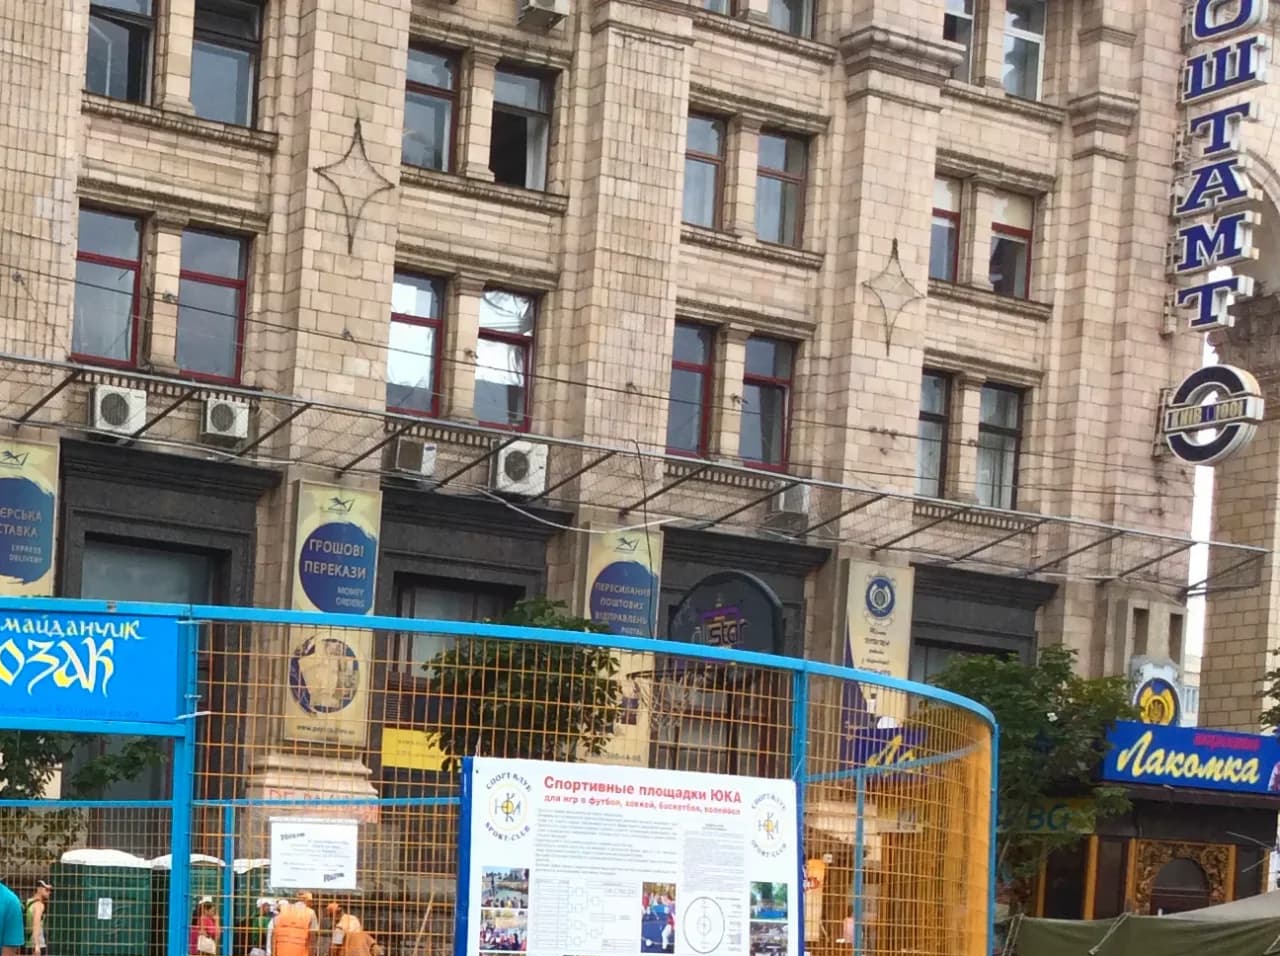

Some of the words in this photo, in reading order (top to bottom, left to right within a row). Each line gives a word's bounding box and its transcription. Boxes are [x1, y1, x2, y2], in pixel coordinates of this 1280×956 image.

[309, 539, 365, 557] ГРОШОВІ
[304, 560, 367, 578] ПЕРЕКАЗИ
[600, 598, 645, 611] ПОШТОВИХ
[1117, 731, 1261, 784] Лакомка
[544, 776, 634, 794] Спортивные
[639, 785, 707, 800] площадки
[711, 789, 742, 803] ЮКА
